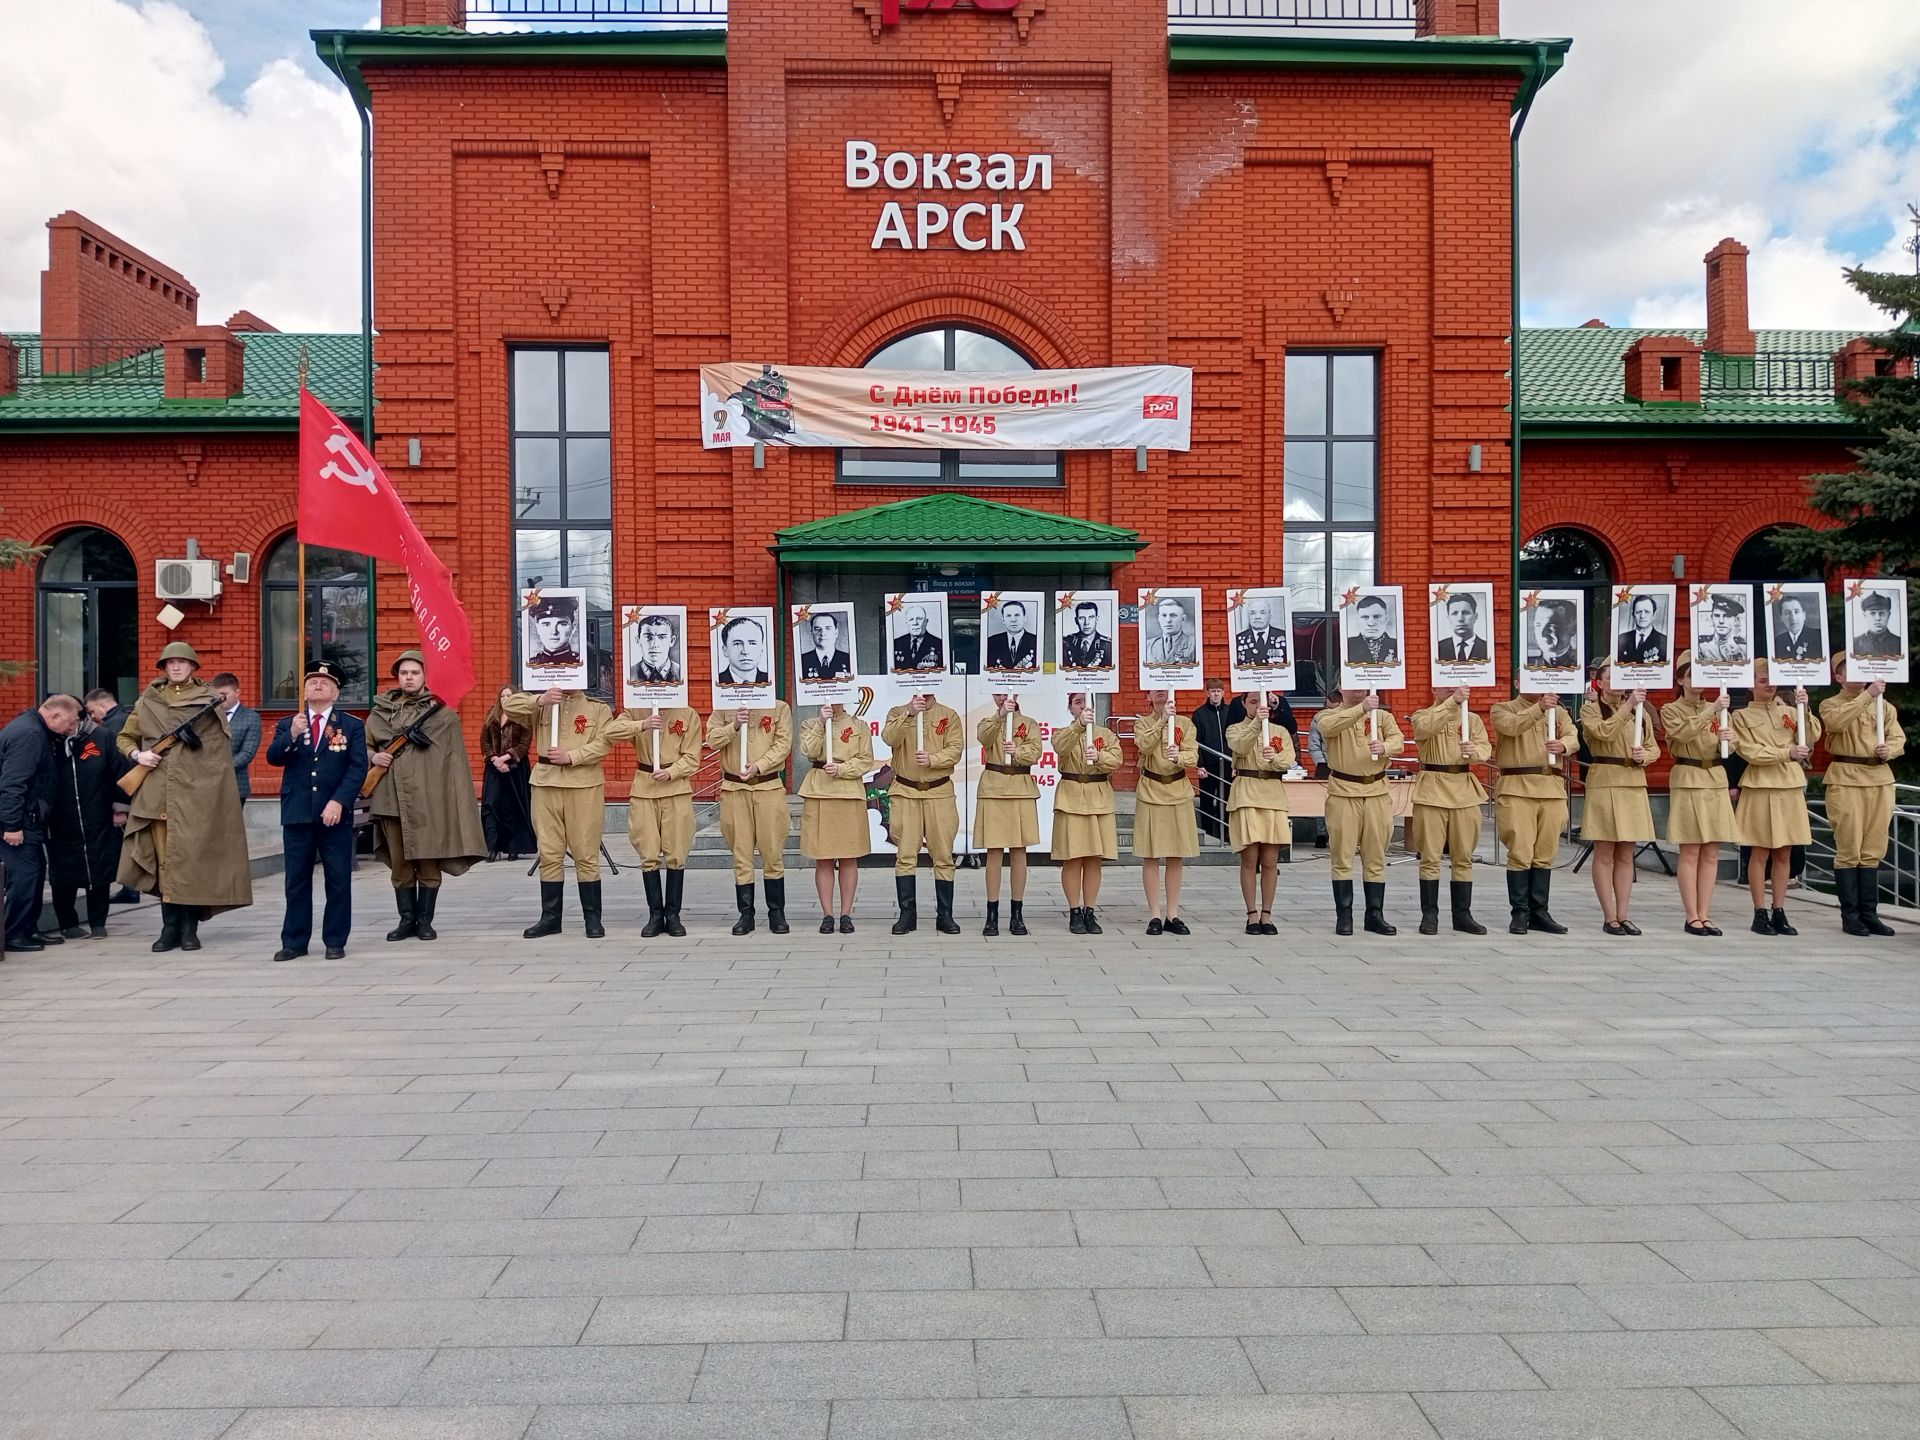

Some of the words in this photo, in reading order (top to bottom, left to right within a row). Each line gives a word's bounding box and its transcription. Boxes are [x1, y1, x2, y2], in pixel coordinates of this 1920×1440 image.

[846, 140, 1052, 190] Вокзал
[871, 201, 1026, 251] АРСК
[869, 385, 885, 404] С
[893, 386, 961, 407] Днём
[969, 384, 1078, 407] Победы!
[713, 409, 728, 430] 9
[712, 431, 731, 443] МАЯ
